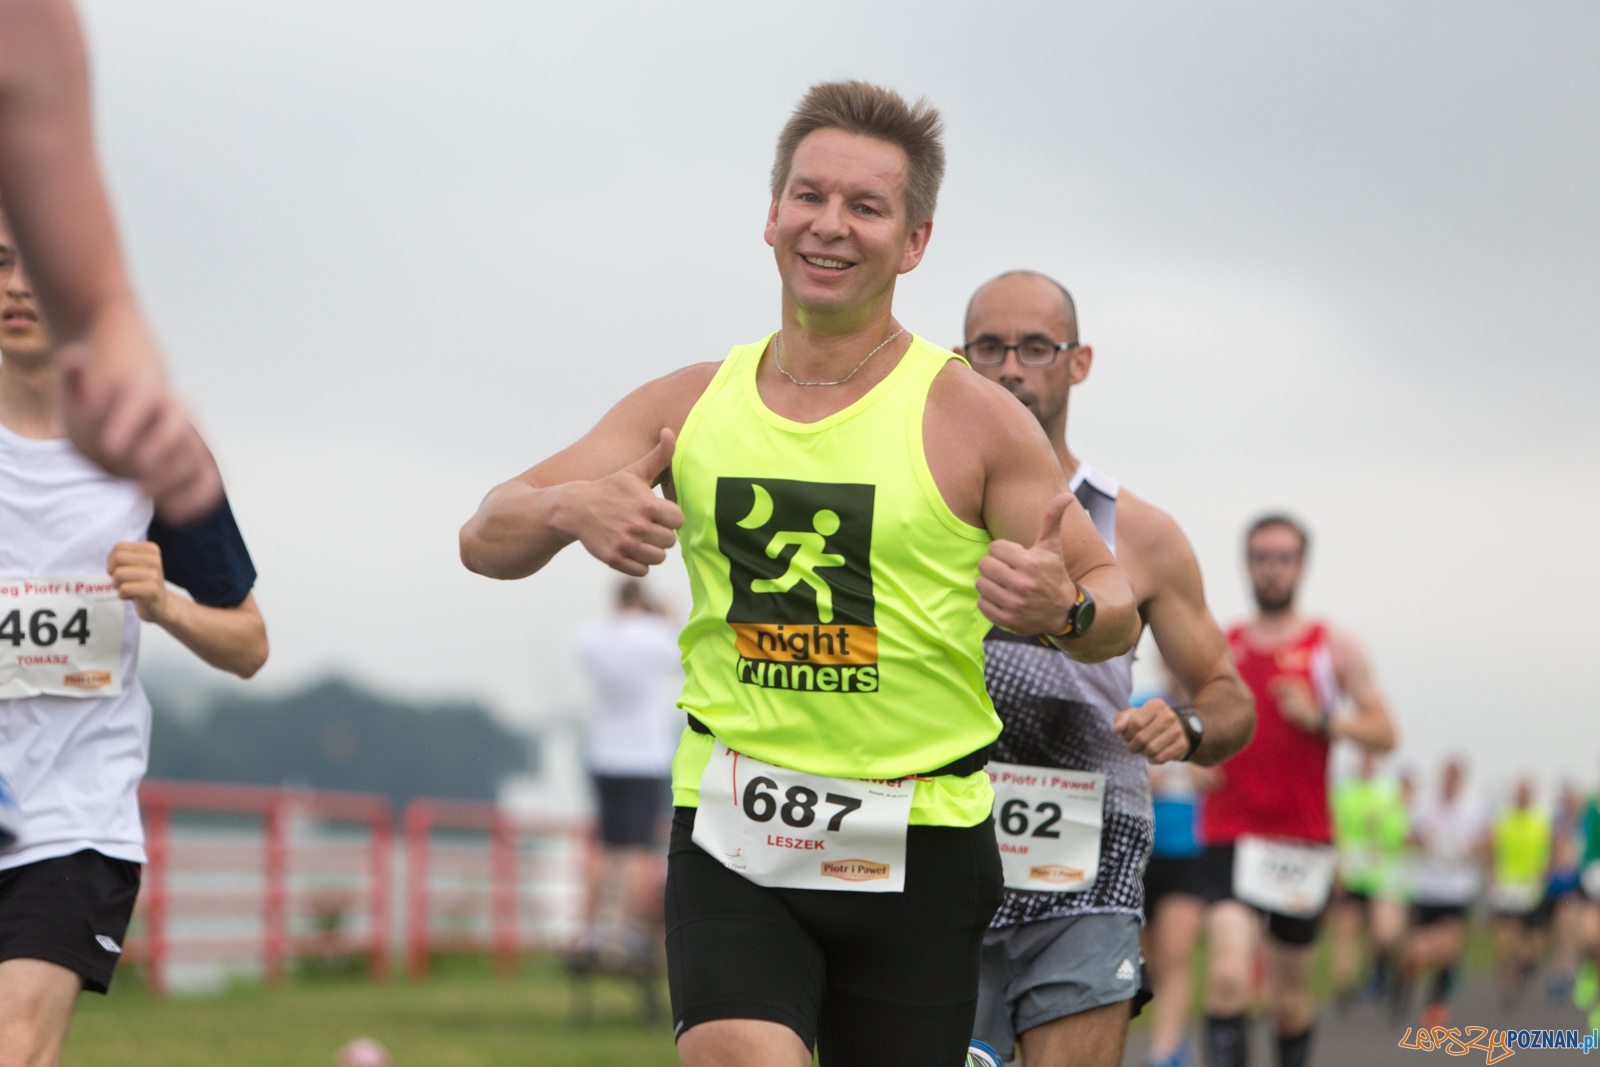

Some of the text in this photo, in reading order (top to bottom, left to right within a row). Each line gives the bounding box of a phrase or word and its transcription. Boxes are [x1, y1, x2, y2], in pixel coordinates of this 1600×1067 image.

[24, 582, 60, 594] Piotr
[0, 608, 90, 646] 464
[757, 625, 849, 660] night
[17, 655, 69, 665] TOMASZ
[738, 658, 878, 692] runners
[1003, 772, 1037, 786] Piotr
[743, 776, 862, 832] 687
[767, 835, 825, 850] LESZEK
[824, 864, 848, 873] Piotr
